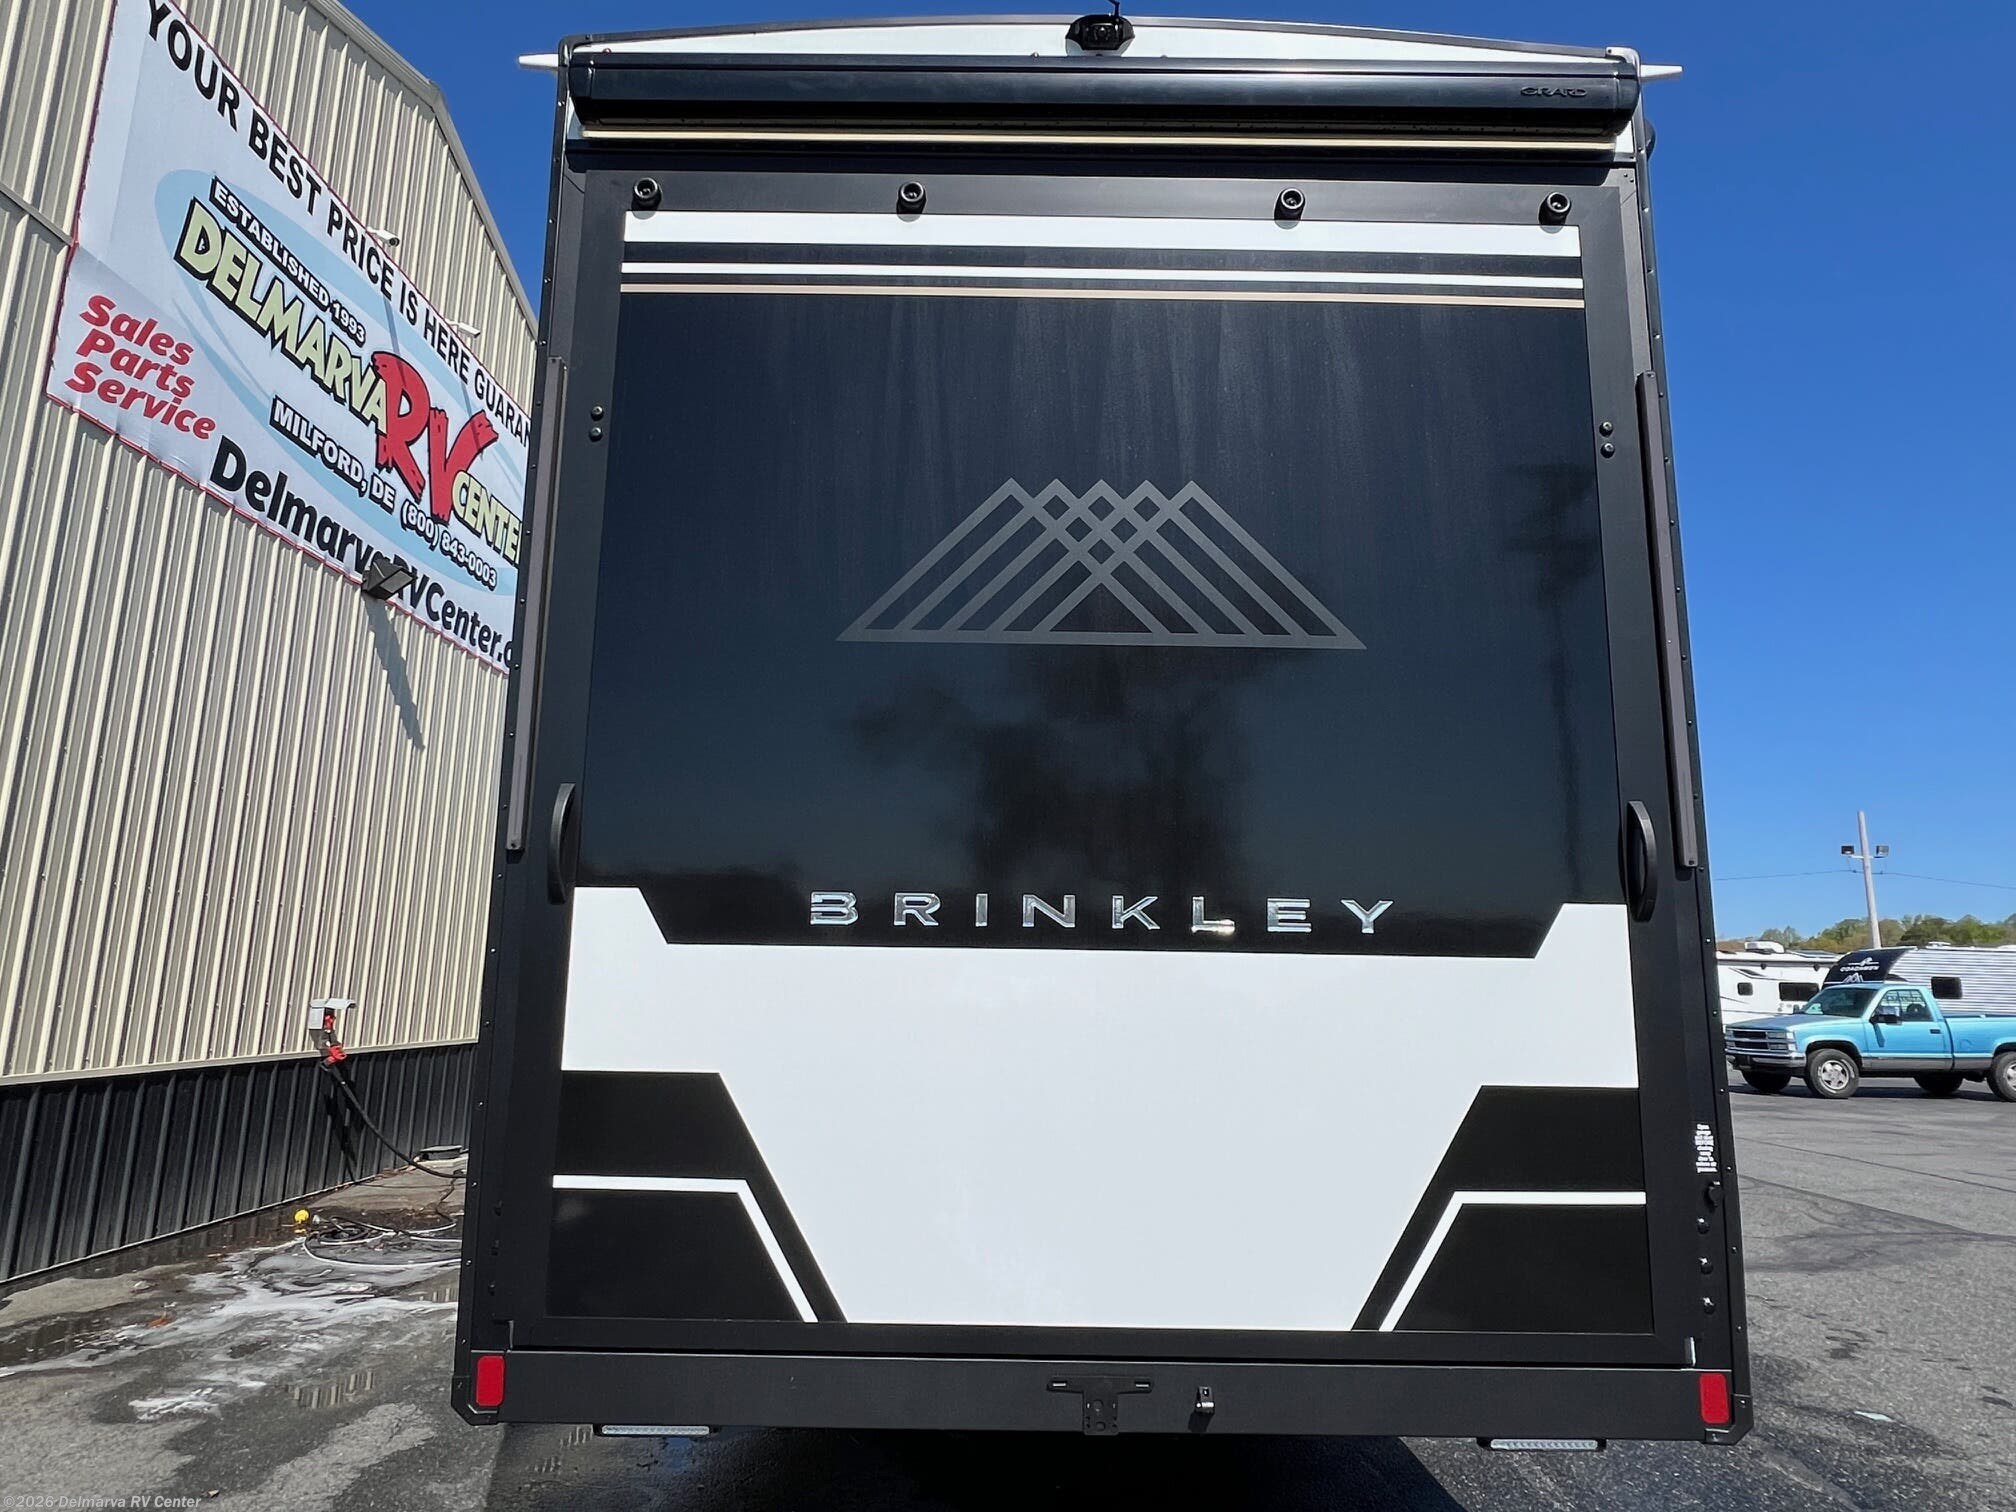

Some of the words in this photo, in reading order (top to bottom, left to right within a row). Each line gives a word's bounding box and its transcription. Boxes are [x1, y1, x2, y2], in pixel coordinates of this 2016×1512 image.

[149, 0, 240, 133] YOUR
[249, 108, 322, 216] BEST
[327, 199, 394, 301] PRICE
[400, 281, 418, 326] IS
[423, 308, 470, 385] HERE
[210, 179, 330, 311] ESTABLISHED
[331, 299, 367, 346] 1993
[76, 328, 195, 398] Parts
[79, 294, 194, 366] Sales
[174, 196, 388, 437] DELMARVA
[371, 351, 500, 527] RV
[451, 469, 522, 567] CENTE
[64, 361, 216, 440] Service
[271, 396, 368, 496] MILFORD,
[369, 474, 396, 514] DE
[402, 502, 440, 548] (800)
[441, 532, 497, 590] 843-0003
[809, 891, 1394, 935] BRINKLEY
